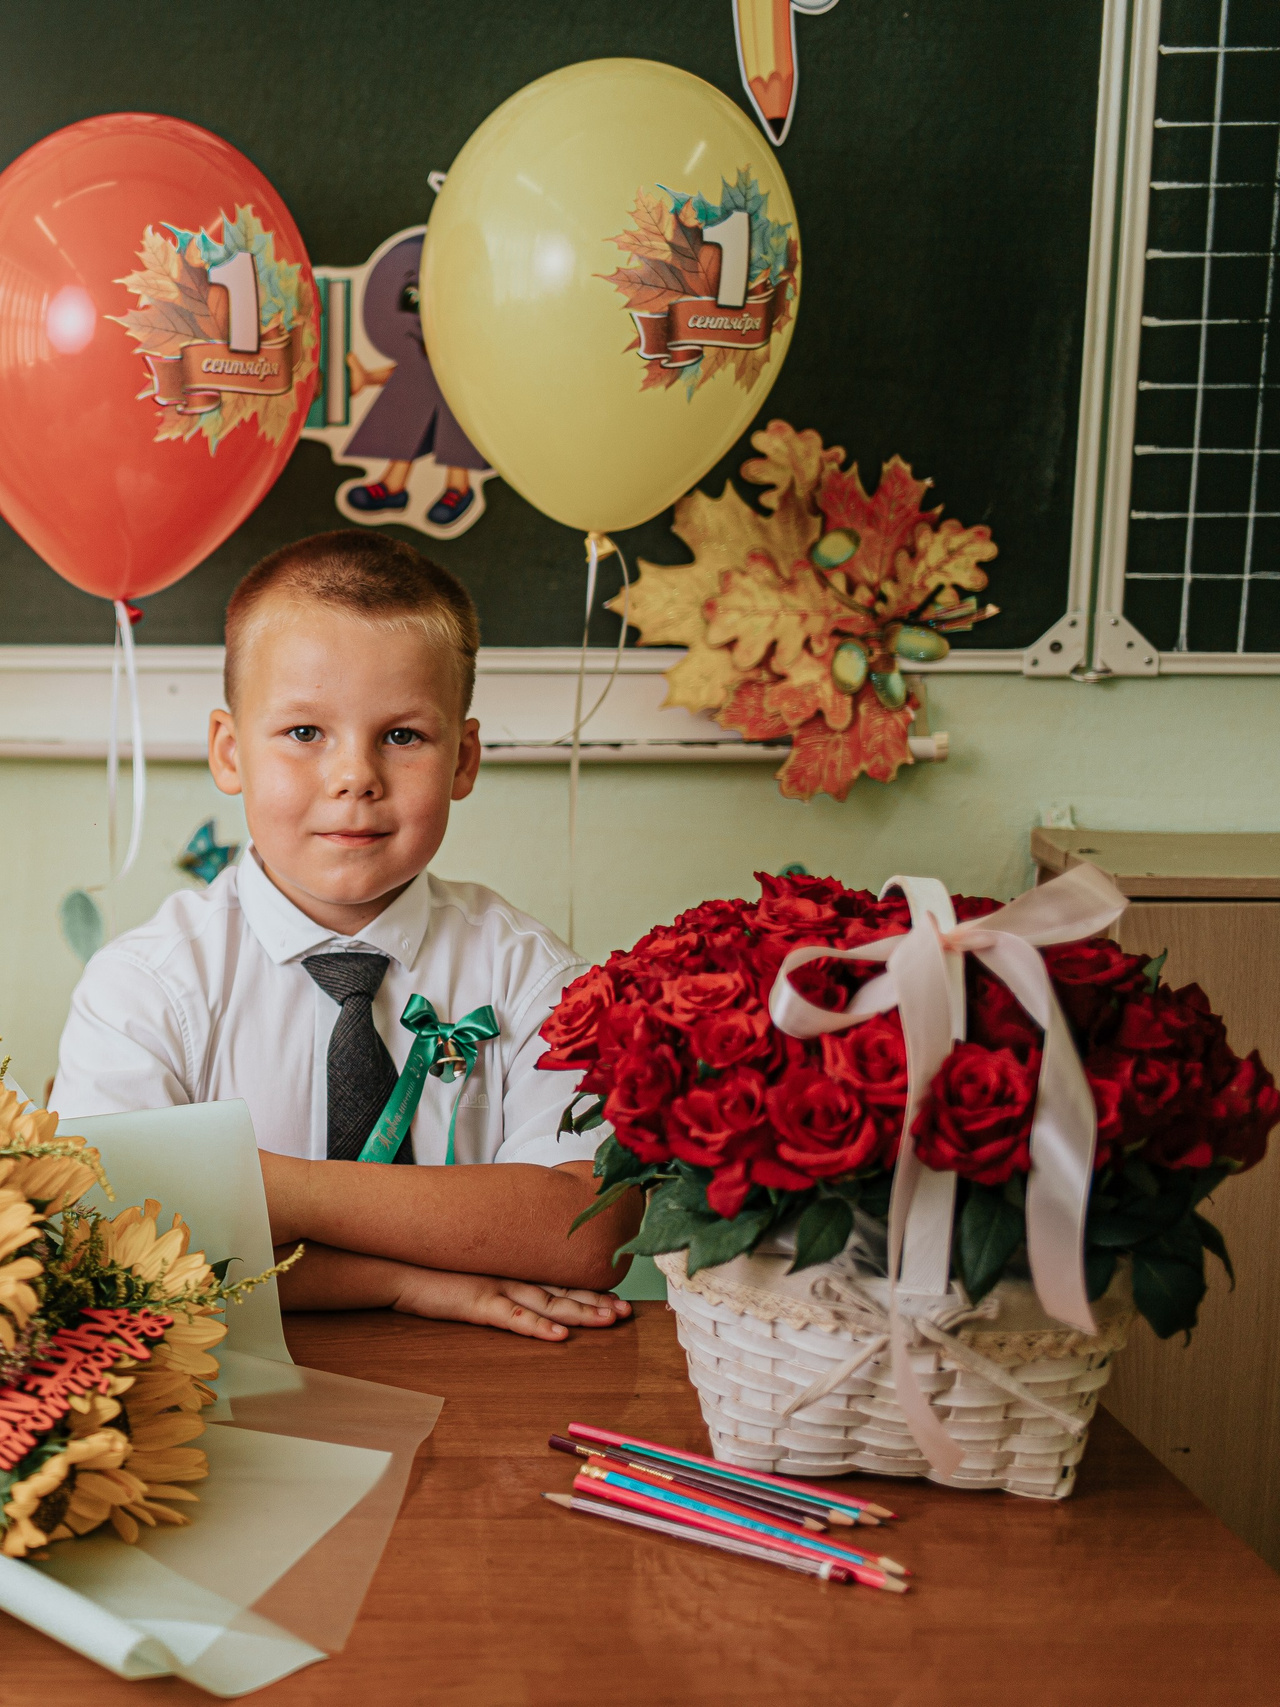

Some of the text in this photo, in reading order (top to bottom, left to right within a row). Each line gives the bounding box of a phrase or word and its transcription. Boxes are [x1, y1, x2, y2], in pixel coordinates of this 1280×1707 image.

[703, 210, 751, 308] 1
[208, 251, 260, 353] 1
[687, 313, 763, 335] сентября
[202, 357, 281, 382] сентября
